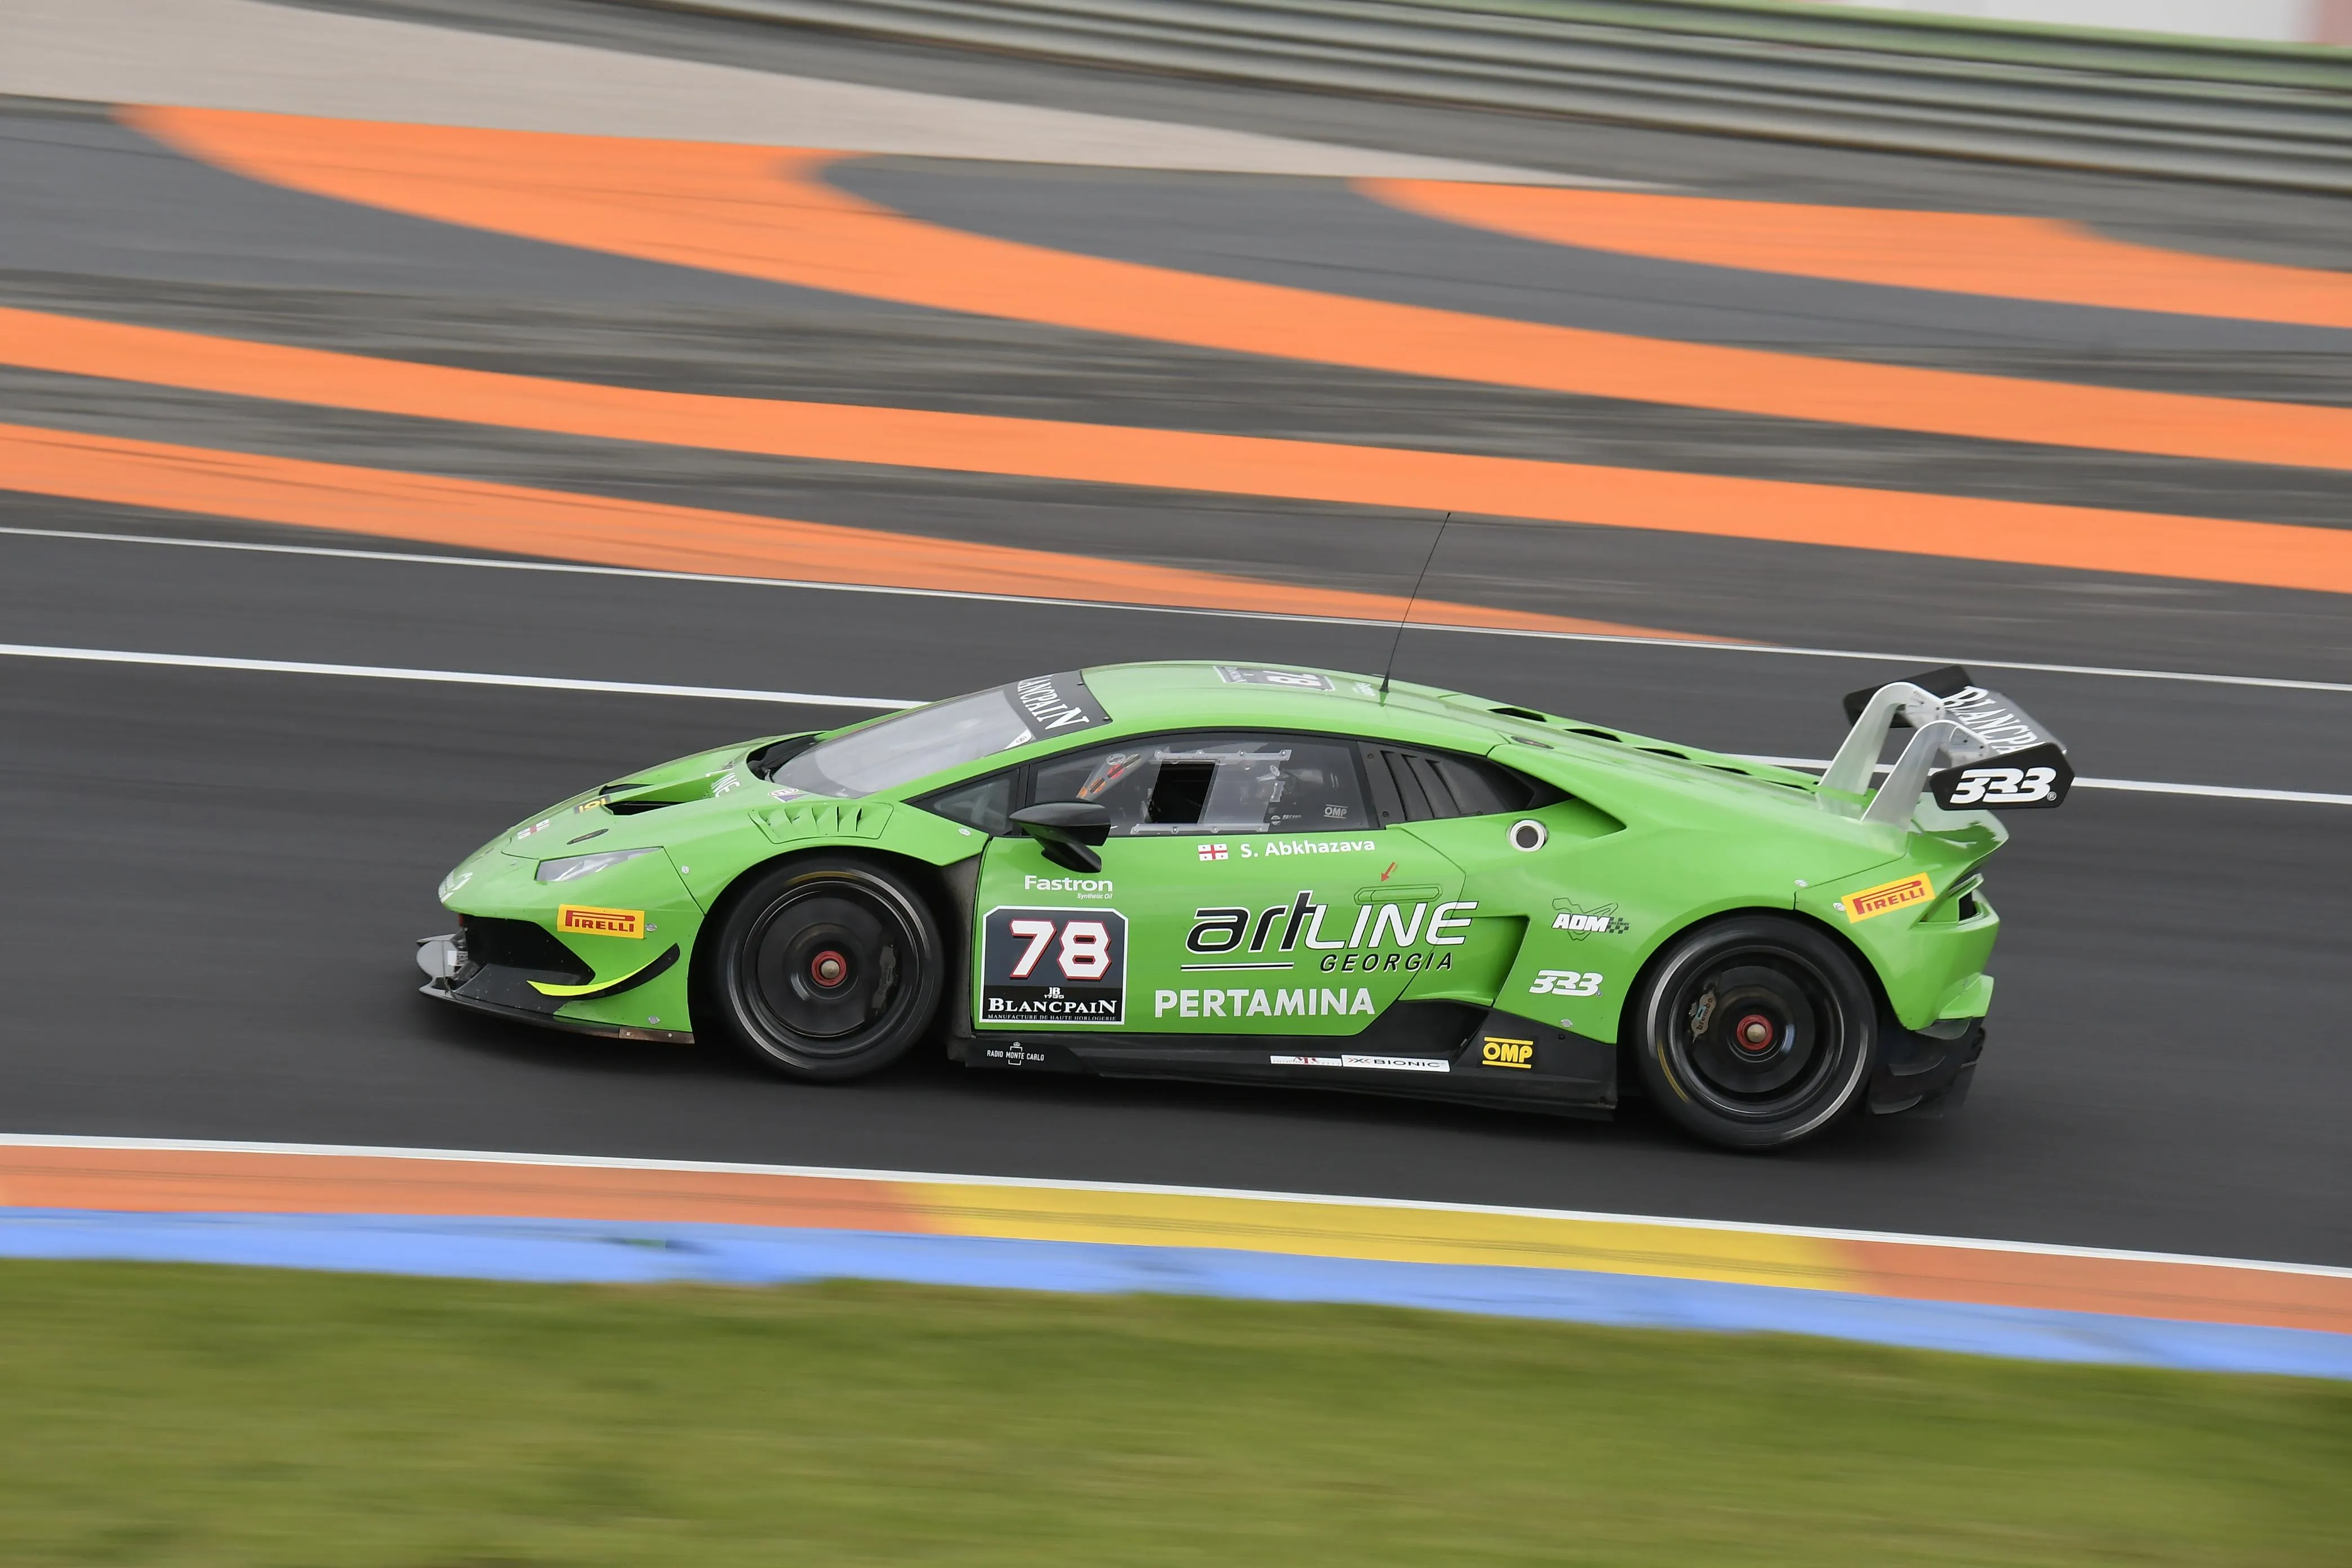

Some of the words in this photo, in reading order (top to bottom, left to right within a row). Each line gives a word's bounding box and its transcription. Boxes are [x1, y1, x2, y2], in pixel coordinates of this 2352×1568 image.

[1017, 675, 1090, 730] LANCPAIN
[1942, 685, 2046, 755] BLANCPA
[1324, 807, 1347, 817] OMP
[1240, 843, 1258, 858] S.
[1265, 840, 1375, 857] Abkhazava
[1024, 875, 1113, 892] Fastron
[1852, 880, 1925, 915] PIRELLI
[565, 910, 635, 932] PIRELLI
[1185, 890, 1479, 955] artLINE
[1552, 912, 1610, 933] ADM
[1009, 919, 1112, 982] 78
[1320, 952, 1453, 973] GEORGIA
[988, 997, 1117, 1014] BLANCPAIN
[1155, 988, 1375, 1018] PERTAMINA
[1696, 998, 1713, 1030] brembo
[1005, 1051, 1024, 1060] MONTE
[1026, 1053, 1044, 1062] CARLO
[1483, 1042, 1533, 1063] OMP
[1374, 1059, 1440, 1068] BIONIC
